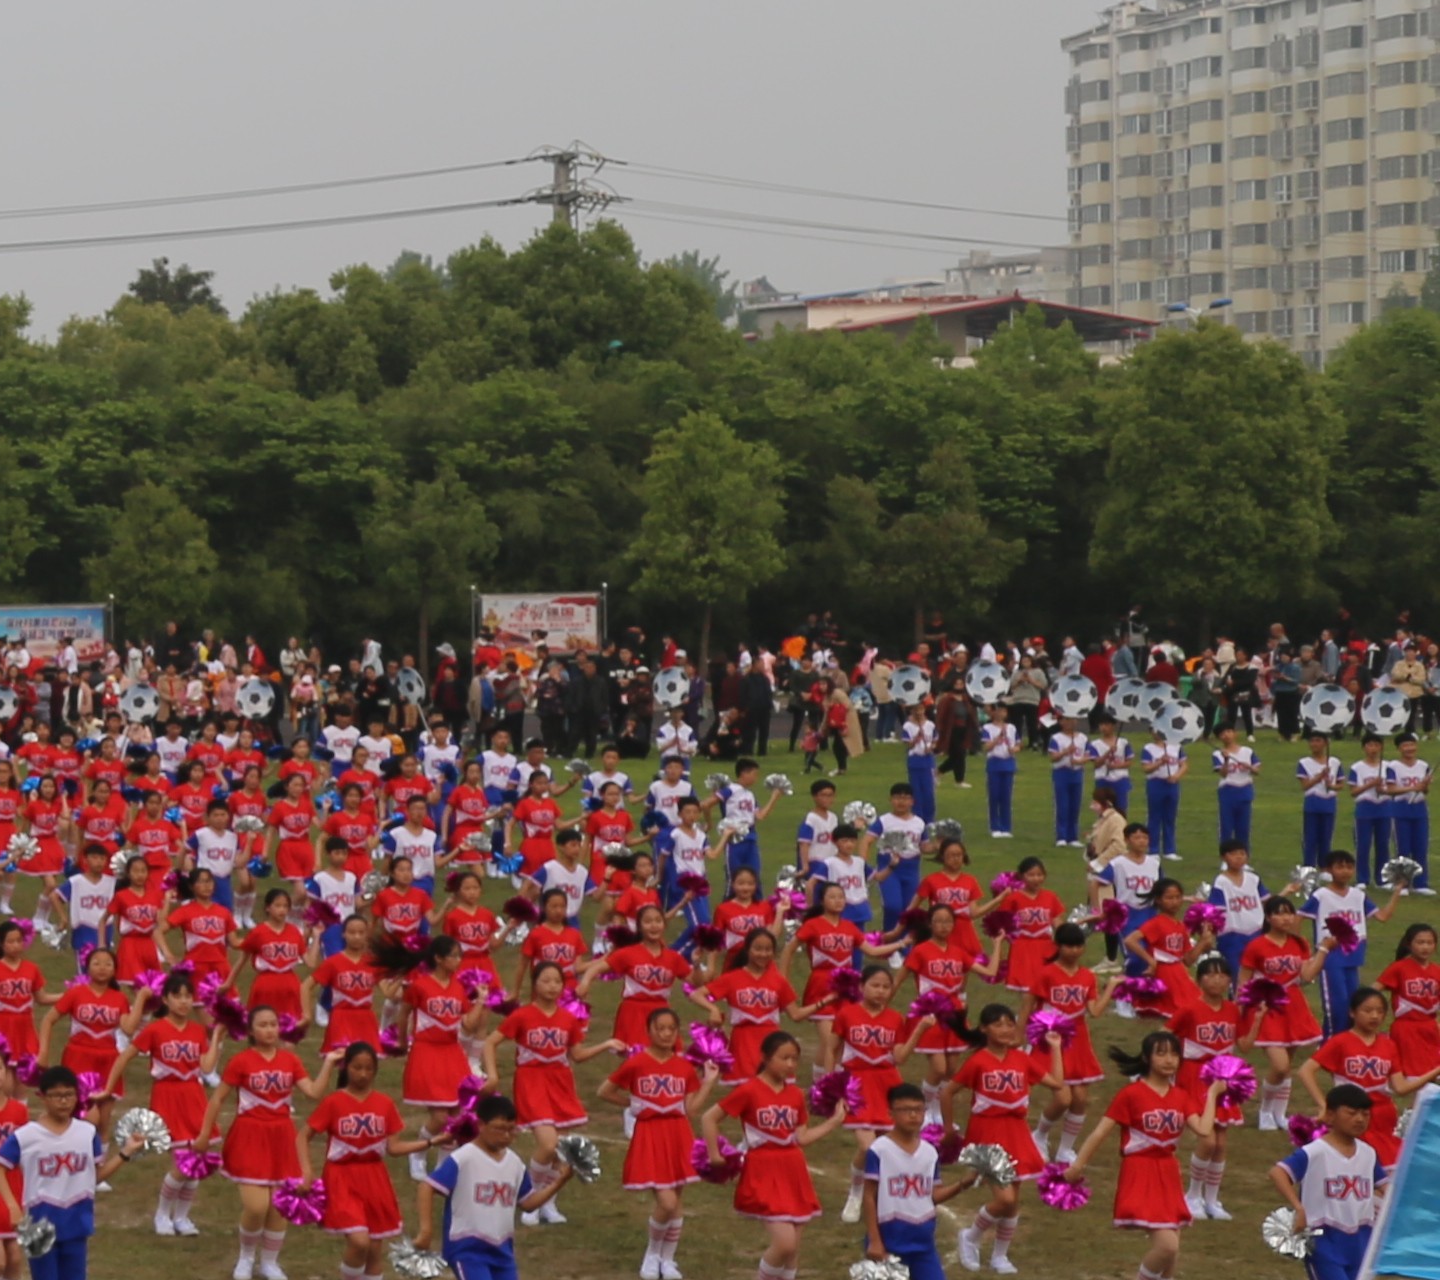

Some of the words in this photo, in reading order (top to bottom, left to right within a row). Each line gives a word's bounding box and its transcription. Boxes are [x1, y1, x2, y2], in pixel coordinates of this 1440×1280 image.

[262, 943, 298, 960] CXU
[930, 959, 964, 977] CXU
[1264, 956, 1302, 972] CXU
[634, 965, 674, 984] CXU
[428, 998, 462, 1016] CXU
[736, 988, 776, 1007] CXU
[77, 1004, 119, 1023] CXU
[527, 1028, 569, 1048] CXU
[850, 1026, 895, 1045] CXU
[1198, 1023, 1235, 1042] CXU
[161, 1043, 199, 1061] CXU
[1346, 1056, 1391, 1078] CXU
[250, 1071, 293, 1092] CXU
[638, 1075, 685, 1096] CXU
[982, 1071, 1024, 1092] CXU
[338, 1112, 385, 1137] CXU
[757, 1106, 798, 1128] CXU
[38, 1153, 87, 1176] CXU
[474, 1181, 517, 1205] CXU
[888, 1174, 931, 1198] CXU
[1324, 1175, 1371, 1200] CXU
